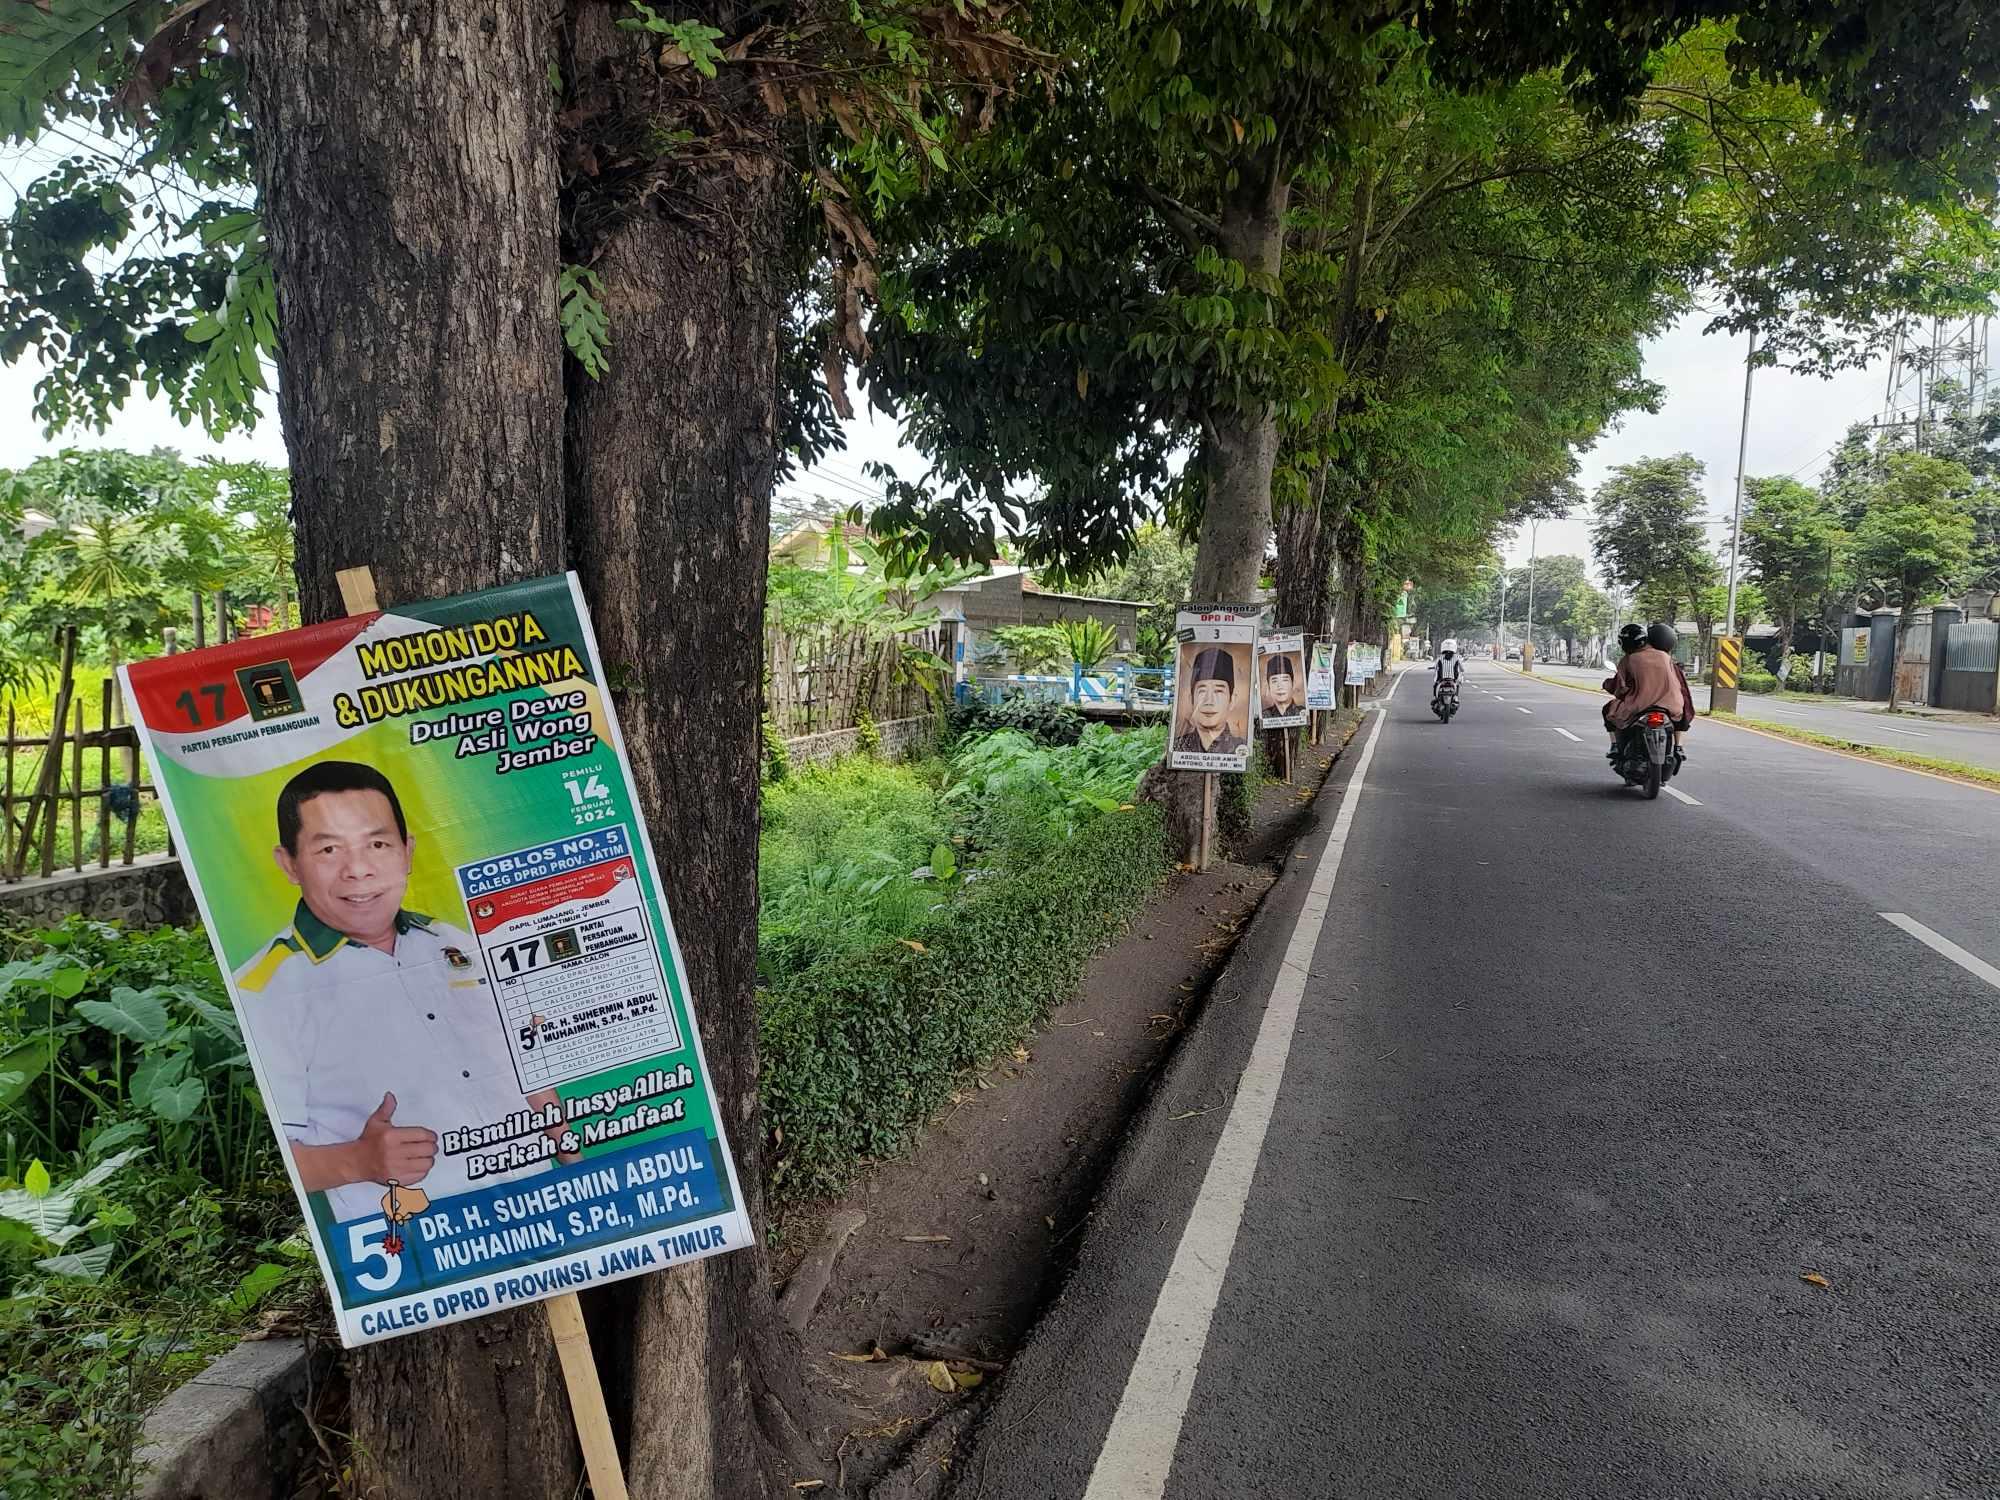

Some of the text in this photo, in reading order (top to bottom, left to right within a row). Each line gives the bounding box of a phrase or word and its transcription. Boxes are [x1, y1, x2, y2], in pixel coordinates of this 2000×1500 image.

[1181, 604, 1256, 614] Calon Anggota
[1200, 614, 1234, 622] DPD RI
[358, 612, 547, 679] MOHON DO'A
[1213, 628, 1220, 640] 3
[176, 683, 227, 726] 17
[334, 647, 585, 728] & DUKUNGANNYA
[181, 716, 321, 754] PARTAI PERSATUAN PEMBANGUNAN
[410, 690, 585, 745] Dulure Dewe
[456, 712, 592, 758] Asli Wong
[496, 735, 598, 775] Jember
[562, 764, 602, 779] PEMILU
[564, 775, 609, 805] 14
[571, 798, 614, 814] FEBRUARI
[574, 806, 616, 825] 2024
[467, 831, 619, 881] COBLOS NO. 5
[469, 844, 624, 894] CALEG DPRD PROV. JATIM
[508, 922, 532, 932] DAPIL
[533, 908, 575, 925] LUMAJANG
[581, 898, 611, 912] JEMBER
[536, 921, 557, 931] JAWA
[559, 914, 581, 924] TIMUR
[580, 920, 605, 933] PARTAI
[582, 926, 623, 943] PERSATUAN
[585, 932, 638, 952] PEMBANGUNAN
[500, 940, 540, 973] 17
[561, 960, 583, 970] NAMA
[584, 952, 610, 963] CALON
[505, 978, 517, 987] NO
[541, 993, 658, 1033] DR. H. SUHERMIN ABDUL
[543, 1004, 658, 1043] MUHAIMIN, S.Pd., M.Pd.
[520, 1027, 535, 1050] 5
[443, 1102, 561, 1155] Bismillah
[466, 1097, 685, 1180] Berkah & Manfaat
[419, 1146, 703, 1242] DR. H. SUHERMIN ABDUL
[433, 1185, 700, 1271] MUHAIMIN, S.Pd., M.Pd.
[348, 1219, 402, 1292] 5
[360, 1225, 727, 1337] CALEG DPRD PROVINSI JAWA TIMUR
